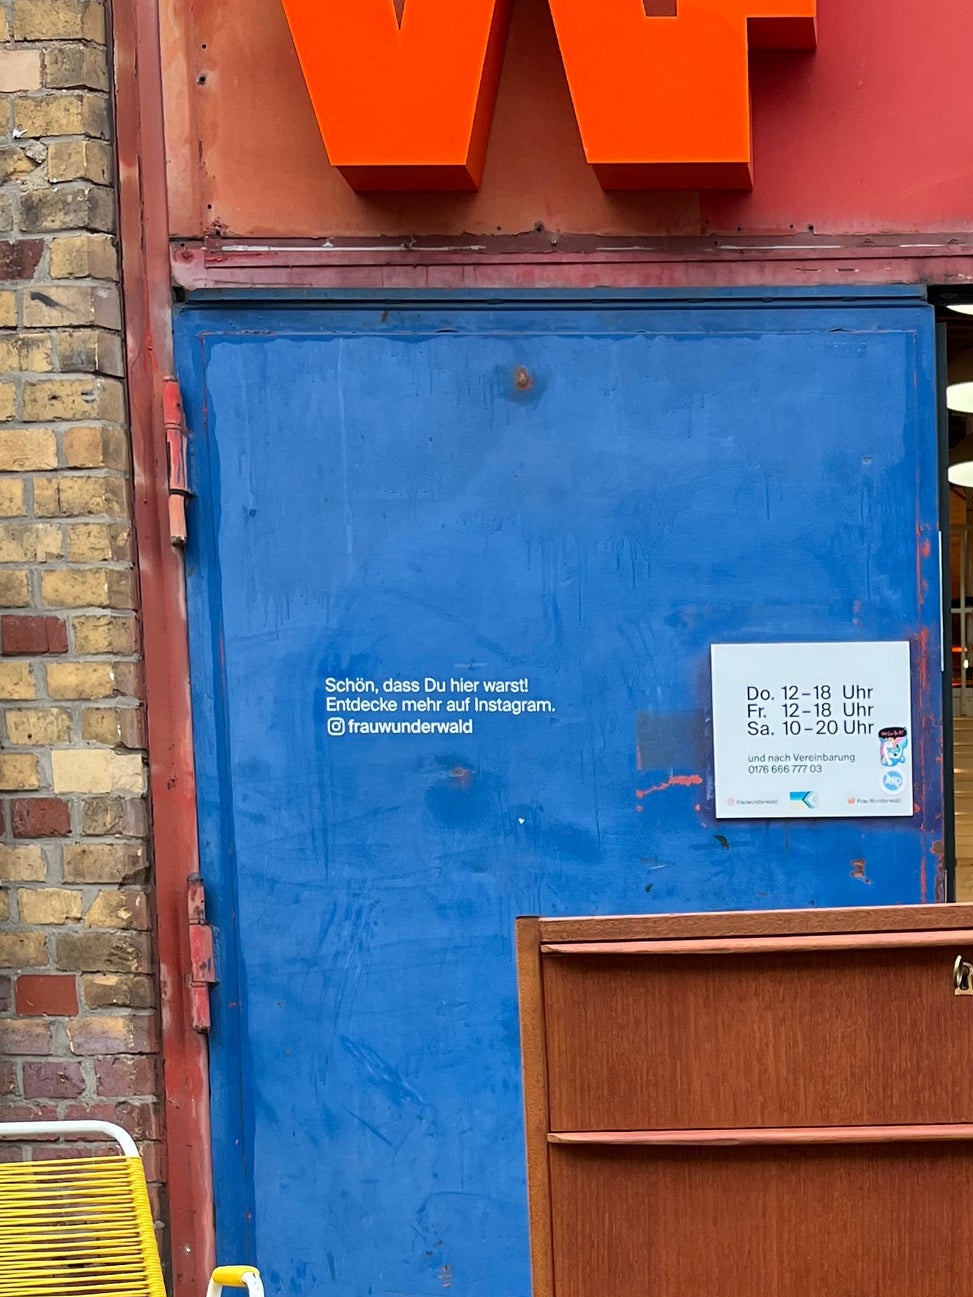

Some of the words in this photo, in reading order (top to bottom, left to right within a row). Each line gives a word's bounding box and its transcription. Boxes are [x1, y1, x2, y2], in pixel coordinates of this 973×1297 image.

[325, 677, 379, 695] Schön,
[383, 677, 420, 693] dass
[424, 678, 446, 693] Du
[450, 677, 480, 693] hier
[484, 677, 529, 693] warst!
[746, 686, 775, 701] Do.
[842, 684, 874, 700] Uhr
[325, 696, 398, 712] Entdecke
[401, 696, 443, 712] mehr
[446, 696, 471, 712] auf
[475, 696, 556, 715] Instagram.
[747, 703, 767, 719] Fr.
[843, 702, 874, 717] Uhr
[347, 718, 474, 734] frauwunderwald
[747, 721, 775, 736] Sa.
[843, 720, 875, 735] Uhr
[747, 754, 766, 763] und
[767, 753, 791, 763] nach
[793, 753, 856, 763] Vereinbarung
[748, 765, 769, 774] 0176
[771, 765, 790, 774] 666
[791, 764, 808, 773] 777
[809, 764, 823, 773] 03
